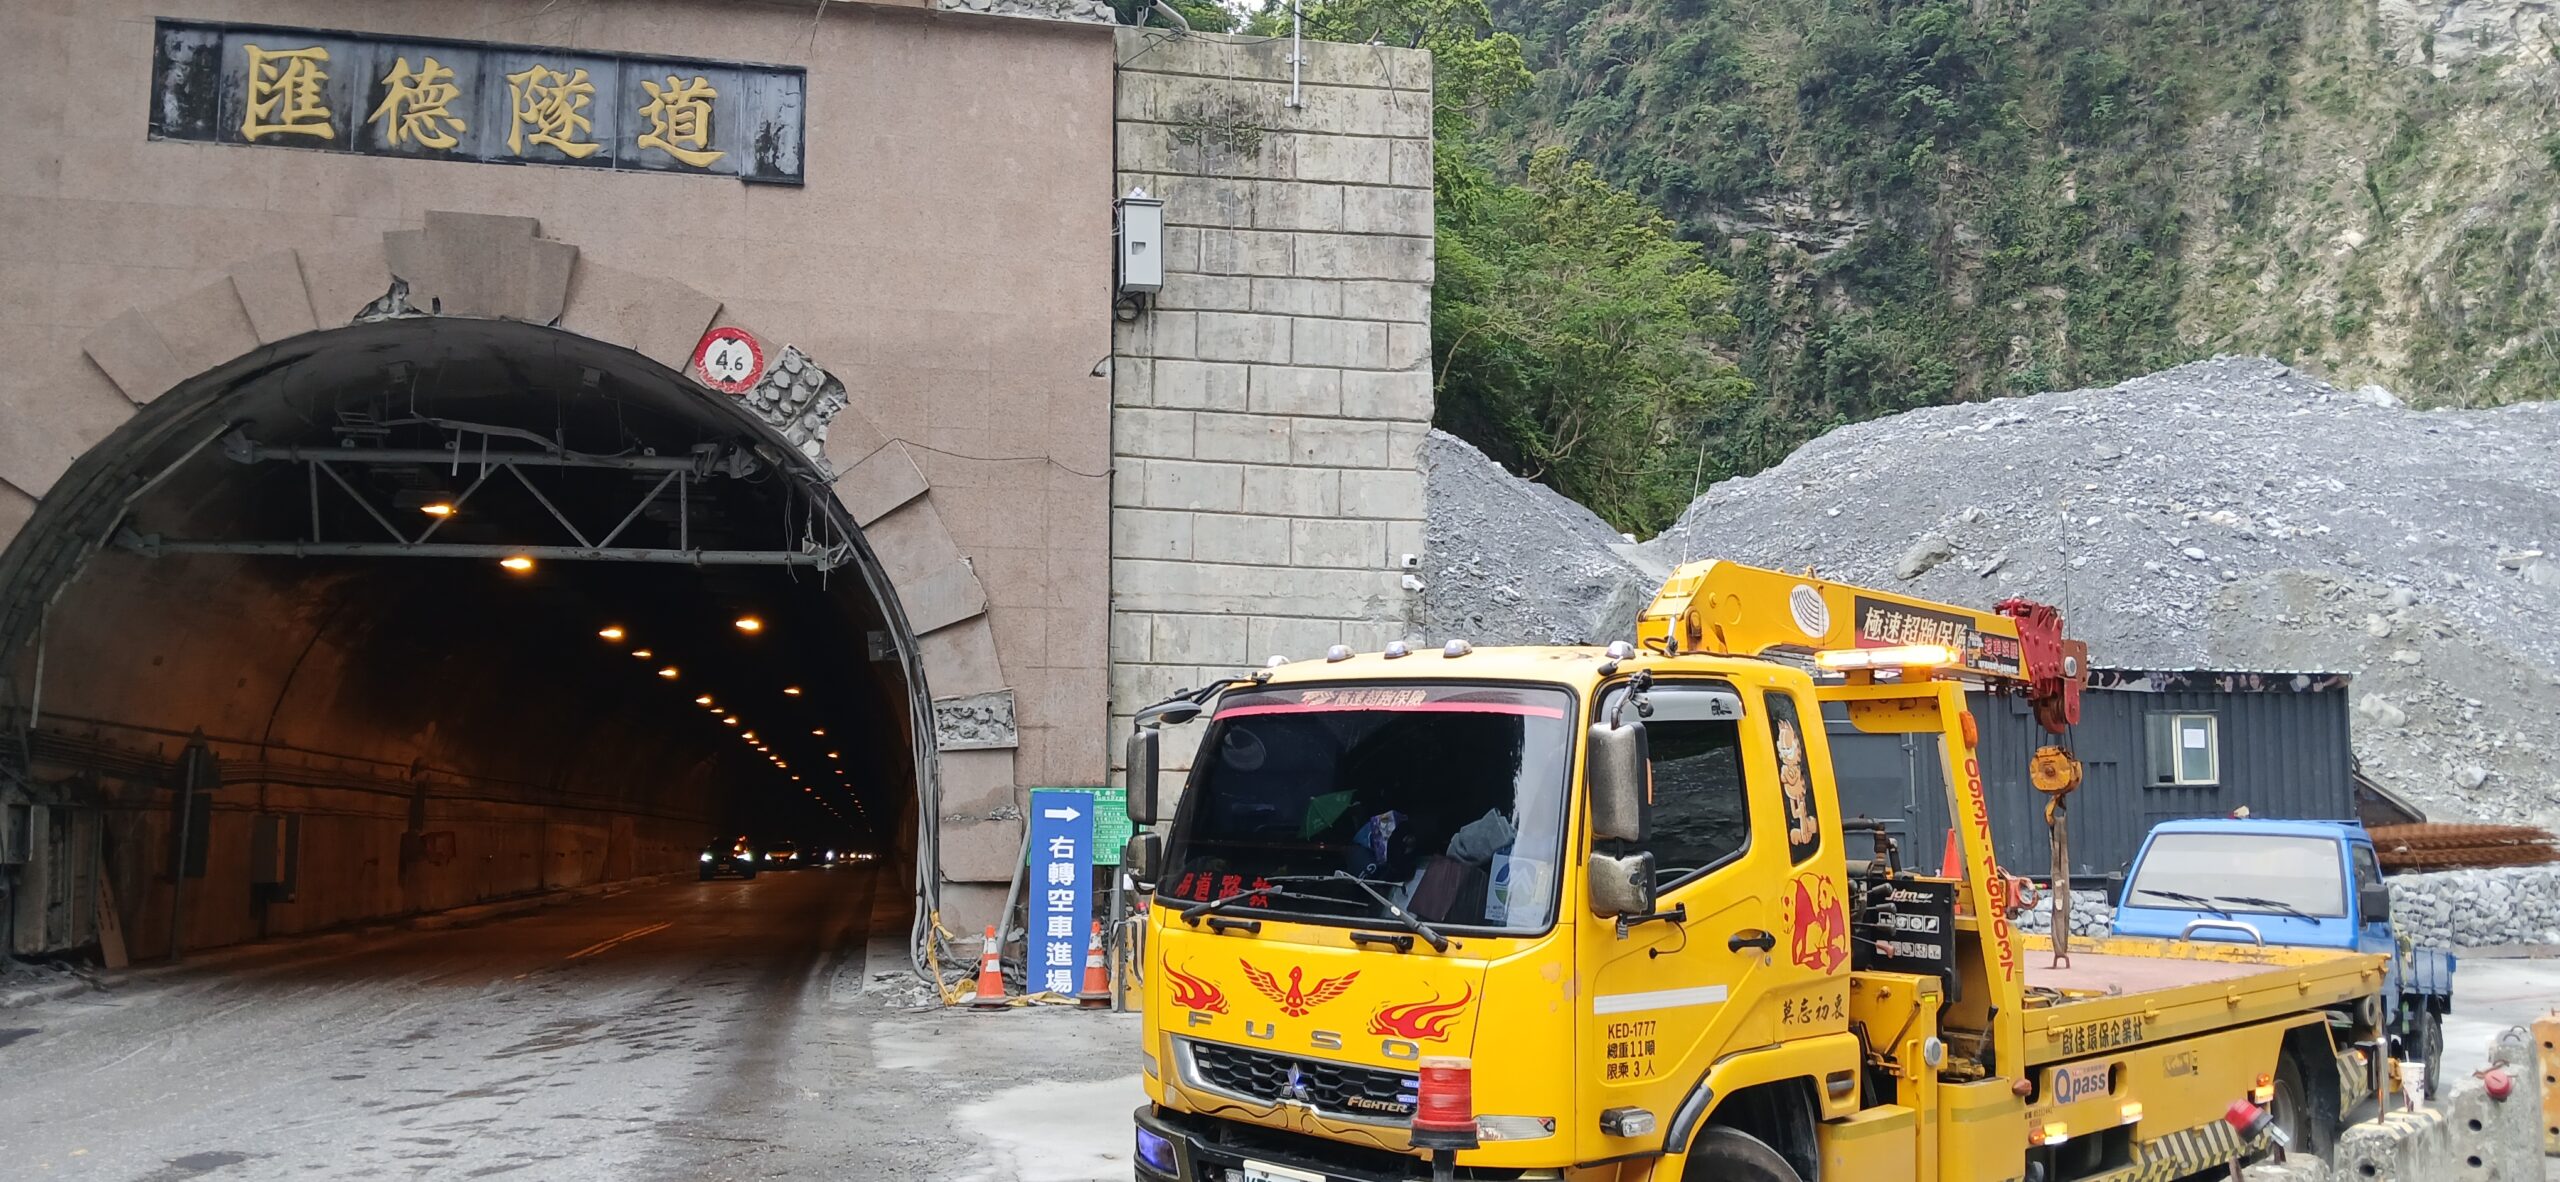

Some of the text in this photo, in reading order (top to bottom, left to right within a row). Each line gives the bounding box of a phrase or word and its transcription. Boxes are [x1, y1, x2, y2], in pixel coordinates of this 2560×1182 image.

[240, 44, 726, 167] 匯德隧道
[715, 350, 743, 371] 4.6
[1045, 835, 1076, 993] 右轉空車進場
[1188, 1011, 1420, 1060] FUSO
[1607, 1020, 1656, 1040] KED-1777
[2055, 1068, 2106, 1104] Qpass
[1347, 1096, 1410, 1113] FIGHTER
